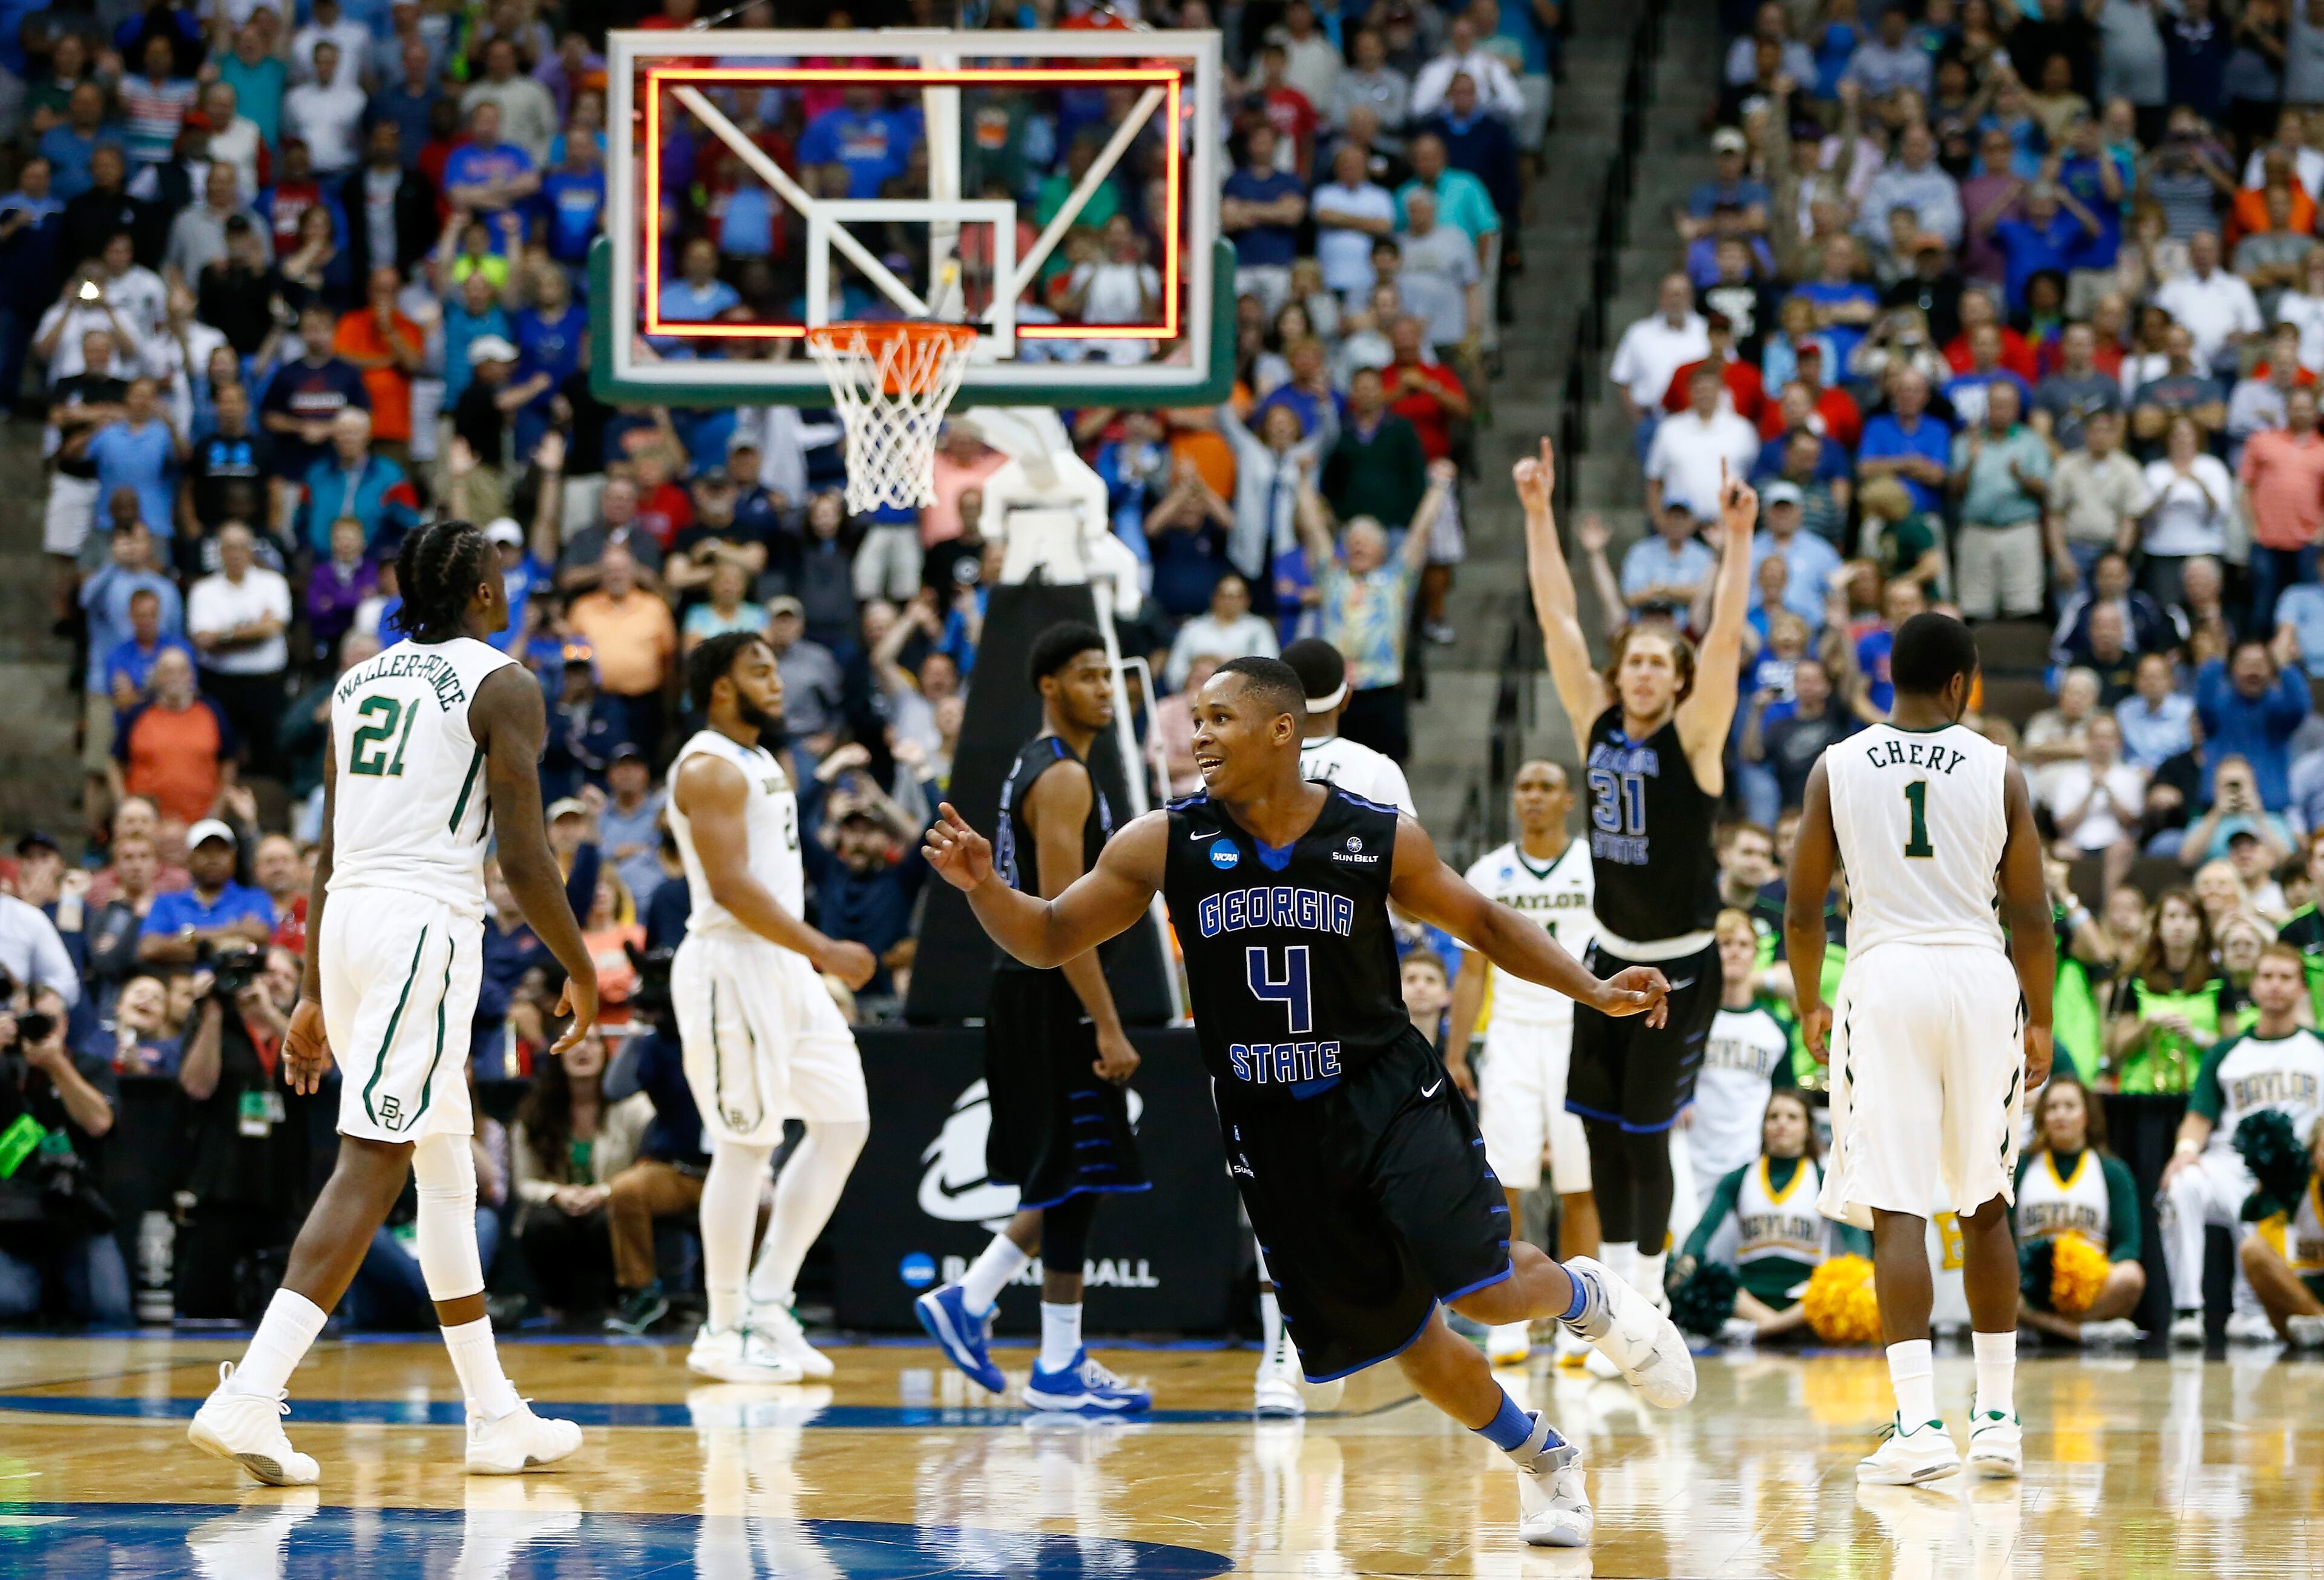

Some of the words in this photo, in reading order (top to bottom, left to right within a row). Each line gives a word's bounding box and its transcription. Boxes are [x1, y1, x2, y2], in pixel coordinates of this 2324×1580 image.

[349, 695, 421, 777] 21
[1866, 741, 1966, 774] CHERY
[1587, 768, 1646, 836] 31
[1904, 780, 1934, 858] 1
[1213, 852, 1238, 862] NCAA
[1199, 886, 1353, 938] GEORGIA
[1246, 946, 1312, 1034] 4
[1230, 1041, 1341, 1084] STATE
